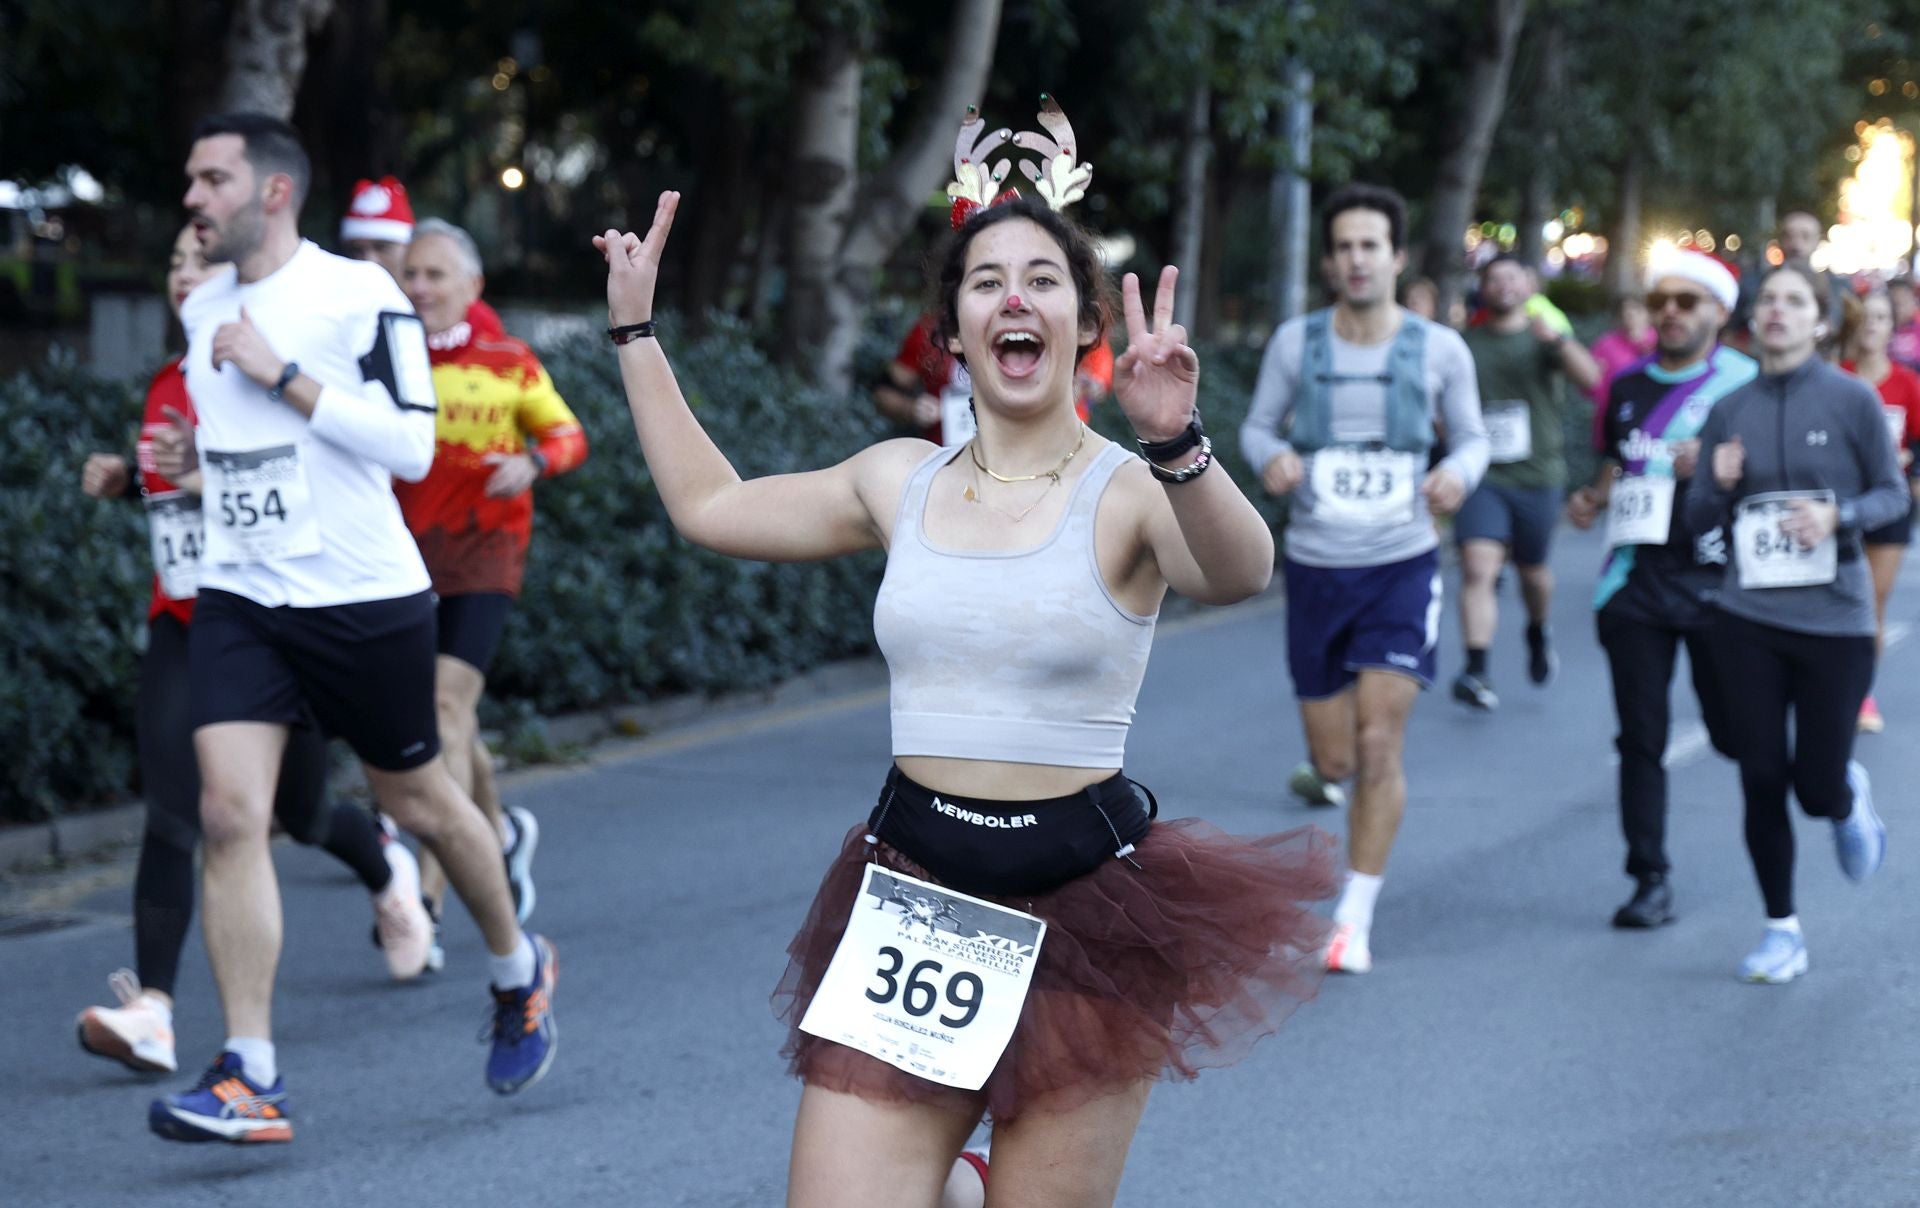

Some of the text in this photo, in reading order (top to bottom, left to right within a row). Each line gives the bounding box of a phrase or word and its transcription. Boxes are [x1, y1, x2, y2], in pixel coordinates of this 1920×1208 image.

[1334, 469, 1392, 498] 823
[220, 489, 287, 527] 554
[930, 796, 1038, 829] NEWBOLER
[897, 931, 942, 951] PALMA
[948, 947, 1022, 975] PALMILLA
[924, 934, 949, 947] SAN
[953, 942, 1024, 969] SILVESTRE
[959, 938, 1024, 963] CARRERA
[969, 929, 1034, 955] XIV
[865, 946, 984, 1029] 369
